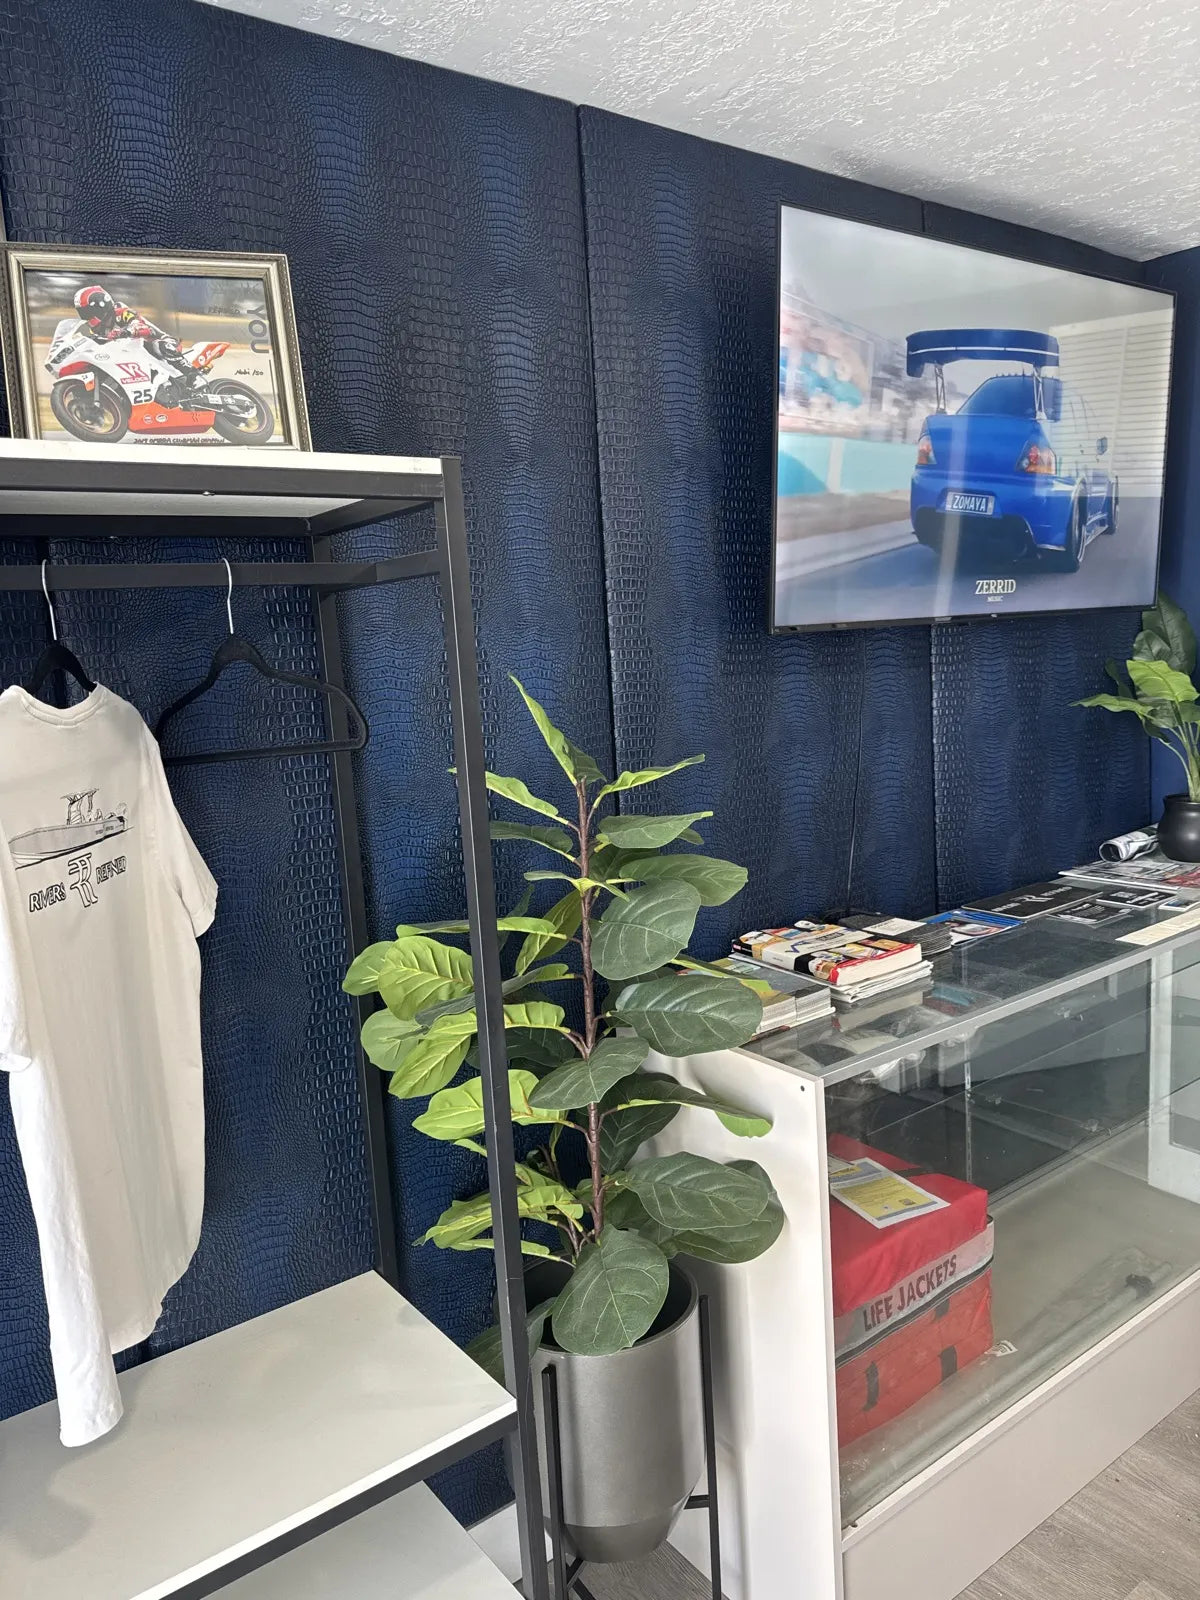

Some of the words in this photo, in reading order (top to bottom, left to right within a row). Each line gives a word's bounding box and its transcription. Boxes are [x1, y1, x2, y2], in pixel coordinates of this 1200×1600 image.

[133, 388, 153, 405] 25
[952, 495, 987, 512] ZOMAYA
[975, 579, 1017, 595] ZERRID
[29, 882, 67, 912] RIVERS
[95, 856, 127, 884] REFINED
[863, 1295, 893, 1332] LIFE
[897, 1254, 957, 1311] JACKETS
